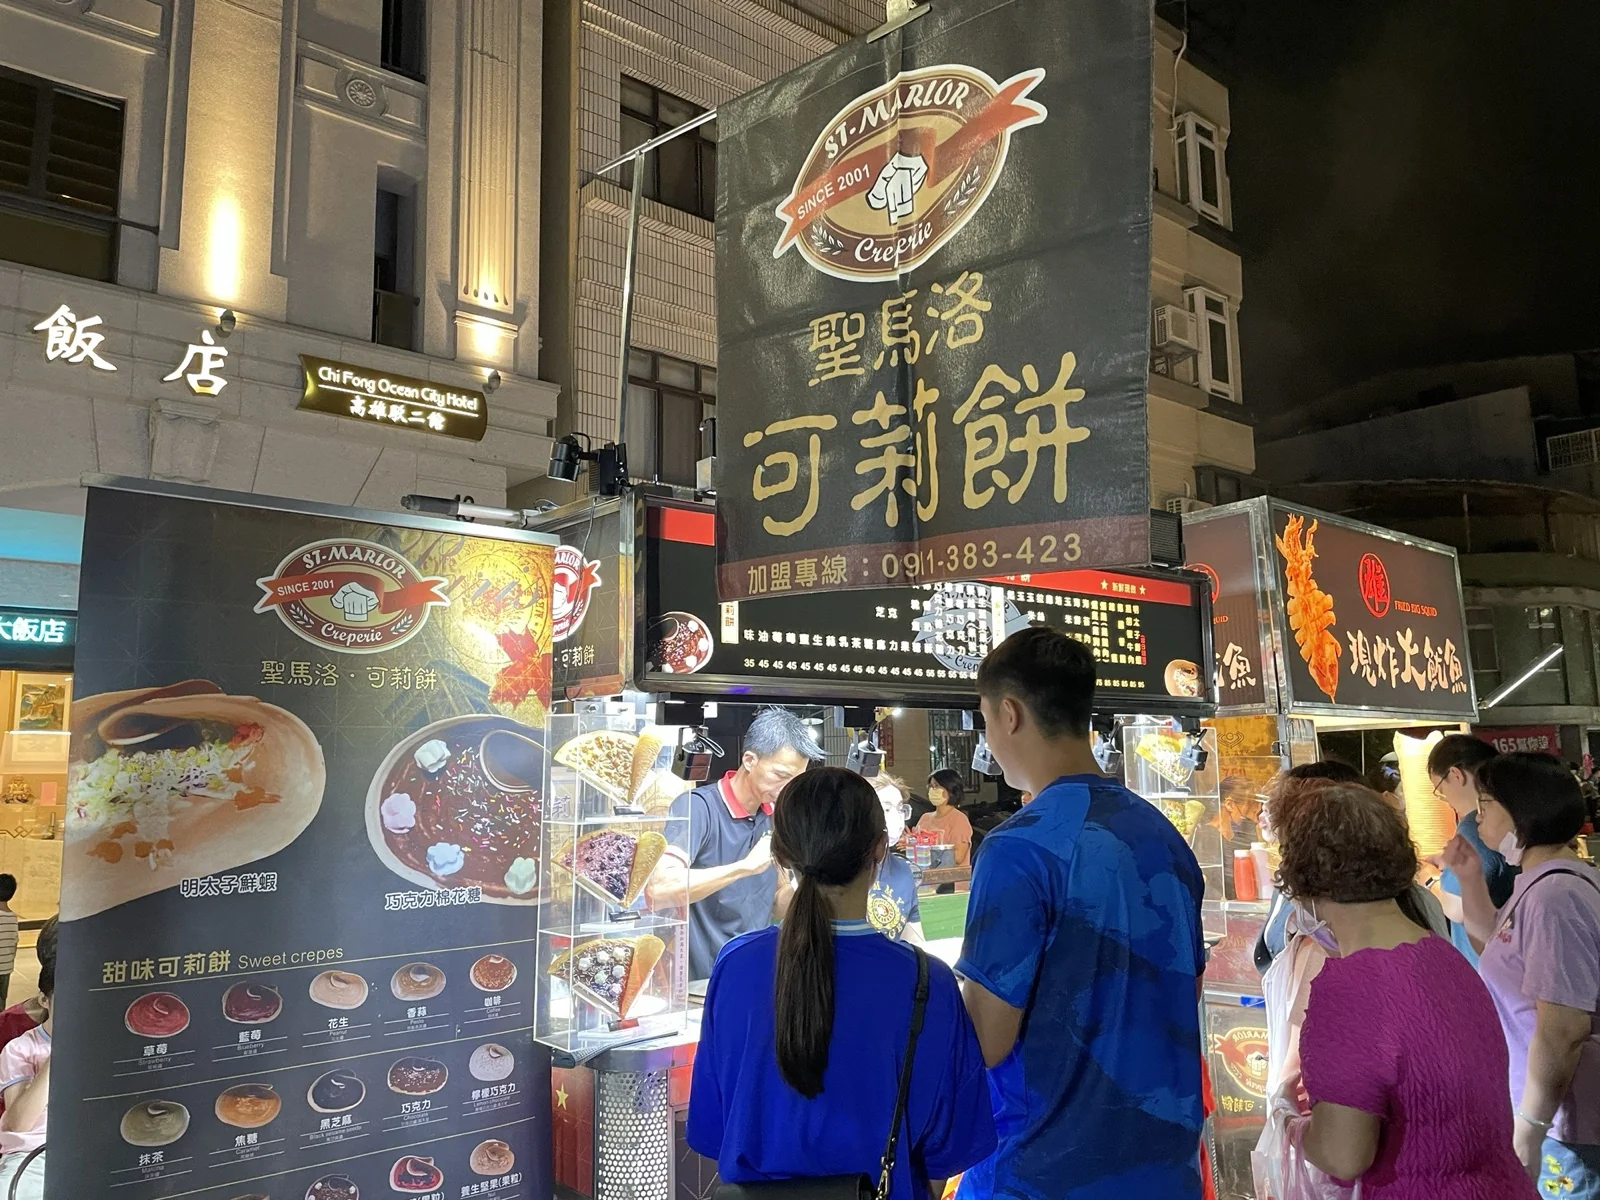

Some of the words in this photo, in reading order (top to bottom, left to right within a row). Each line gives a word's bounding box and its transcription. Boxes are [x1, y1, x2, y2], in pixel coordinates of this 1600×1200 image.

[797, 186, 836, 220] SINCE
[837, 163, 871, 193] 2001
[808, 271, 993, 387] 聖馬洛
[318, 366, 340, 382] Chi
[343, 371, 376, 392] Fong
[378, 379, 419, 399] Ocean
[421, 387, 445, 406] City
[447, 393, 478, 410] Hotel
[743, 351, 1091, 537] 可莉餅
[277, 582, 310, 597] SINCE
[312, 579, 335, 590] 2001
[1411, 604, 1421, 614] BIG
[1421, 605, 1438, 617] SQUID
[321, 622, 384, 646] Creperie
[744, 658, 755, 668] 35
[759, 659, 769, 669] 45
[773, 660, 783, 670] 45
[787, 661, 797, 671] 45
[801, 661, 811, 671] 45
[814, 662, 824, 672] 45
[827, 663, 837, 673] 45
[840, 663, 850, 673] 45
[853, 664, 863, 674] 45
[866, 665, 875, 675] 45
[878, 666, 888, 675] 45
[890, 666, 900, 676] 45
[902, 667, 912, 677] 45
[914, 668, 923, 677] 45
[180, 872, 277, 897] 明太子鮮蝦
[385, 886, 482, 910] 巧克力棉花糖
[102, 950, 231, 984] 甜味可莉餅
[238, 951, 287, 970] Sweet
[291, 947, 344, 964] crepes
[328, 1017, 349, 1029] 花生
[238, 1030, 262, 1043] 藍莓
[142, 1044, 168, 1057] 草莓
[401, 1099, 431, 1114] 巧克力
[320, 1114, 352, 1130] 黑芝麻
[234, 1132, 259, 1147] 焦糖
[138, 1151, 164, 1167] 抹茶
[460, 1172, 523, 1197] 養生堅果(果粒)
